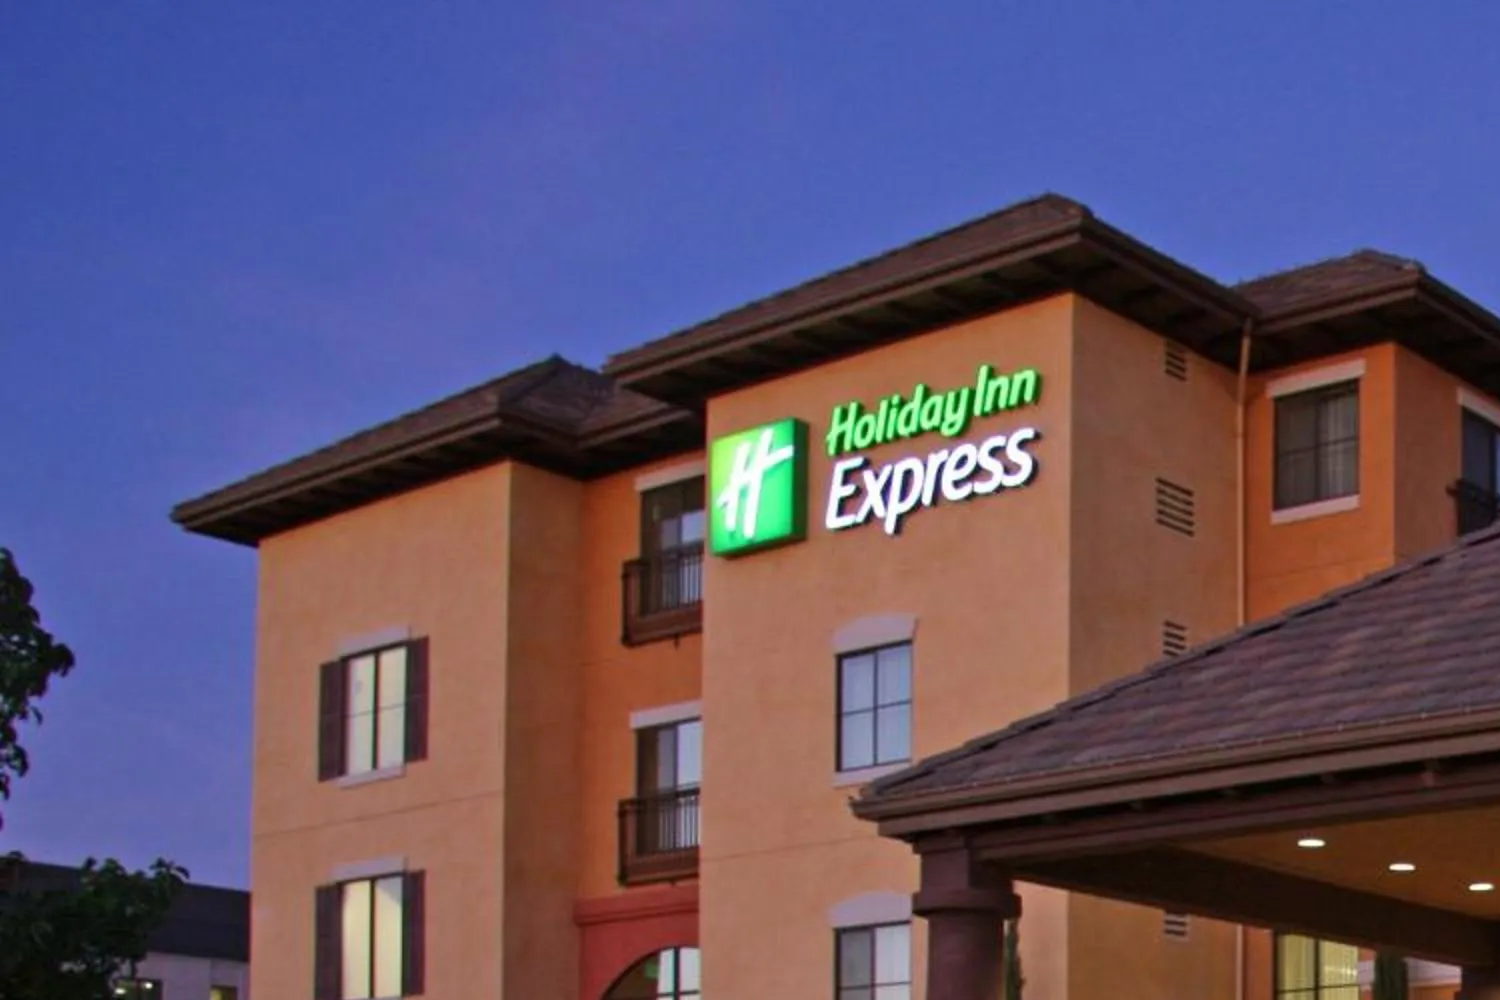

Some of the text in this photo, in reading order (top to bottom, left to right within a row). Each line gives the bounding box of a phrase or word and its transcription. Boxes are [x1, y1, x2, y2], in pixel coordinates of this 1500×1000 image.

[826, 365, 1037, 456] Holiday Inn
[825, 427, 1037, 535] Express
